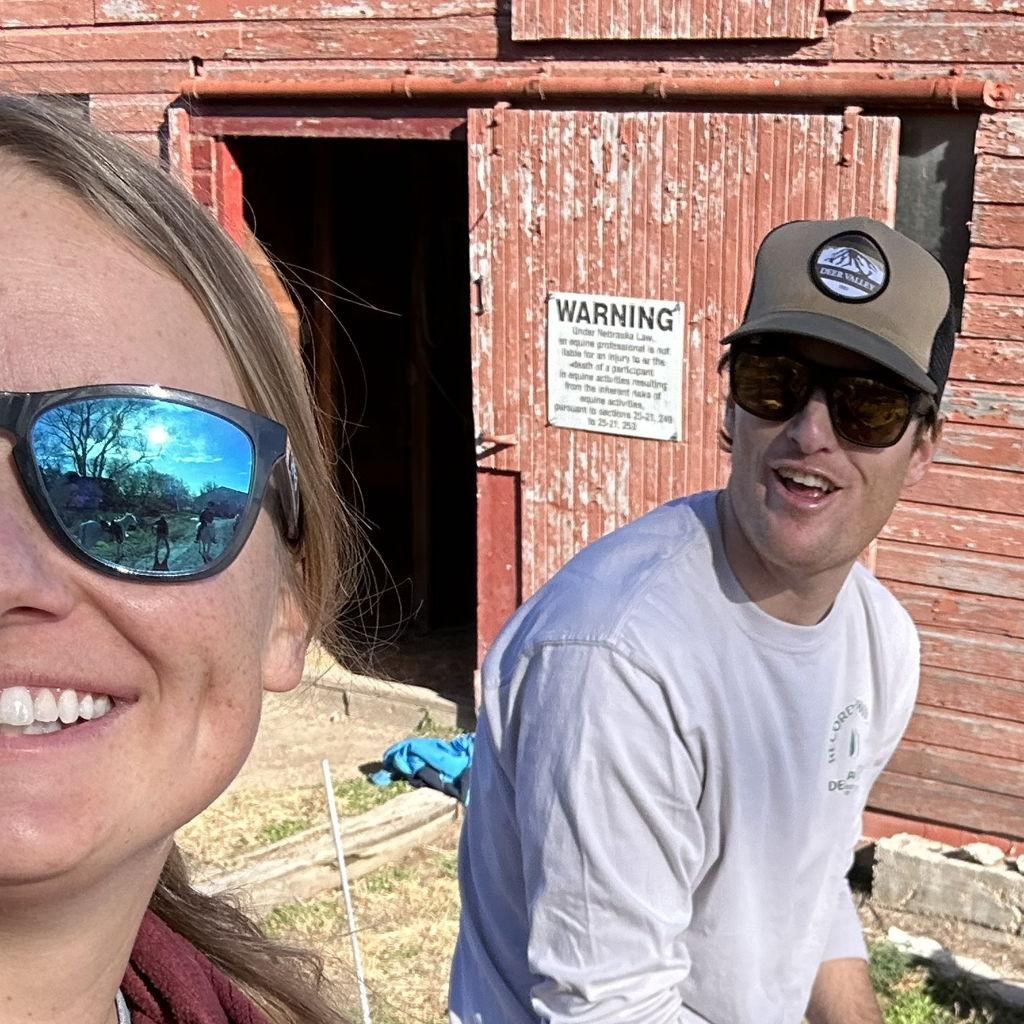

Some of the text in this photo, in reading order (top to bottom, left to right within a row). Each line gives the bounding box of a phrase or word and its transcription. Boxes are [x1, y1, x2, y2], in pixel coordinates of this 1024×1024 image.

[820, 268, 843, 278] DEER
[844, 273, 875, 291] VALLEY
[556, 299, 673, 332] WARNING
[572, 327, 595, 337] Under
[598, 329, 634, 340] Nebraska
[569, 340, 594, 349] equine
[597, 341, 645, 352] professional
[648, 345, 654, 353] is
[657, 346, 670, 355] not
[562, 348, 581, 358] liable
[584, 350, 594, 358] for
[608, 352, 629, 364] injury
[632, 355, 640, 363] to
[653, 358, 665, 366] the
[571, 361, 592, 370] death
[596, 362, 602, 370] of
[612, 365, 654, 377] participant
[560, 370, 668, 391] in equine activities resulting
[565, 382, 661, 400] from the inherent risks of
[580, 396, 605, 406] equine
[554, 403, 587, 414] pursuant
[599, 408, 630, 418] sections
